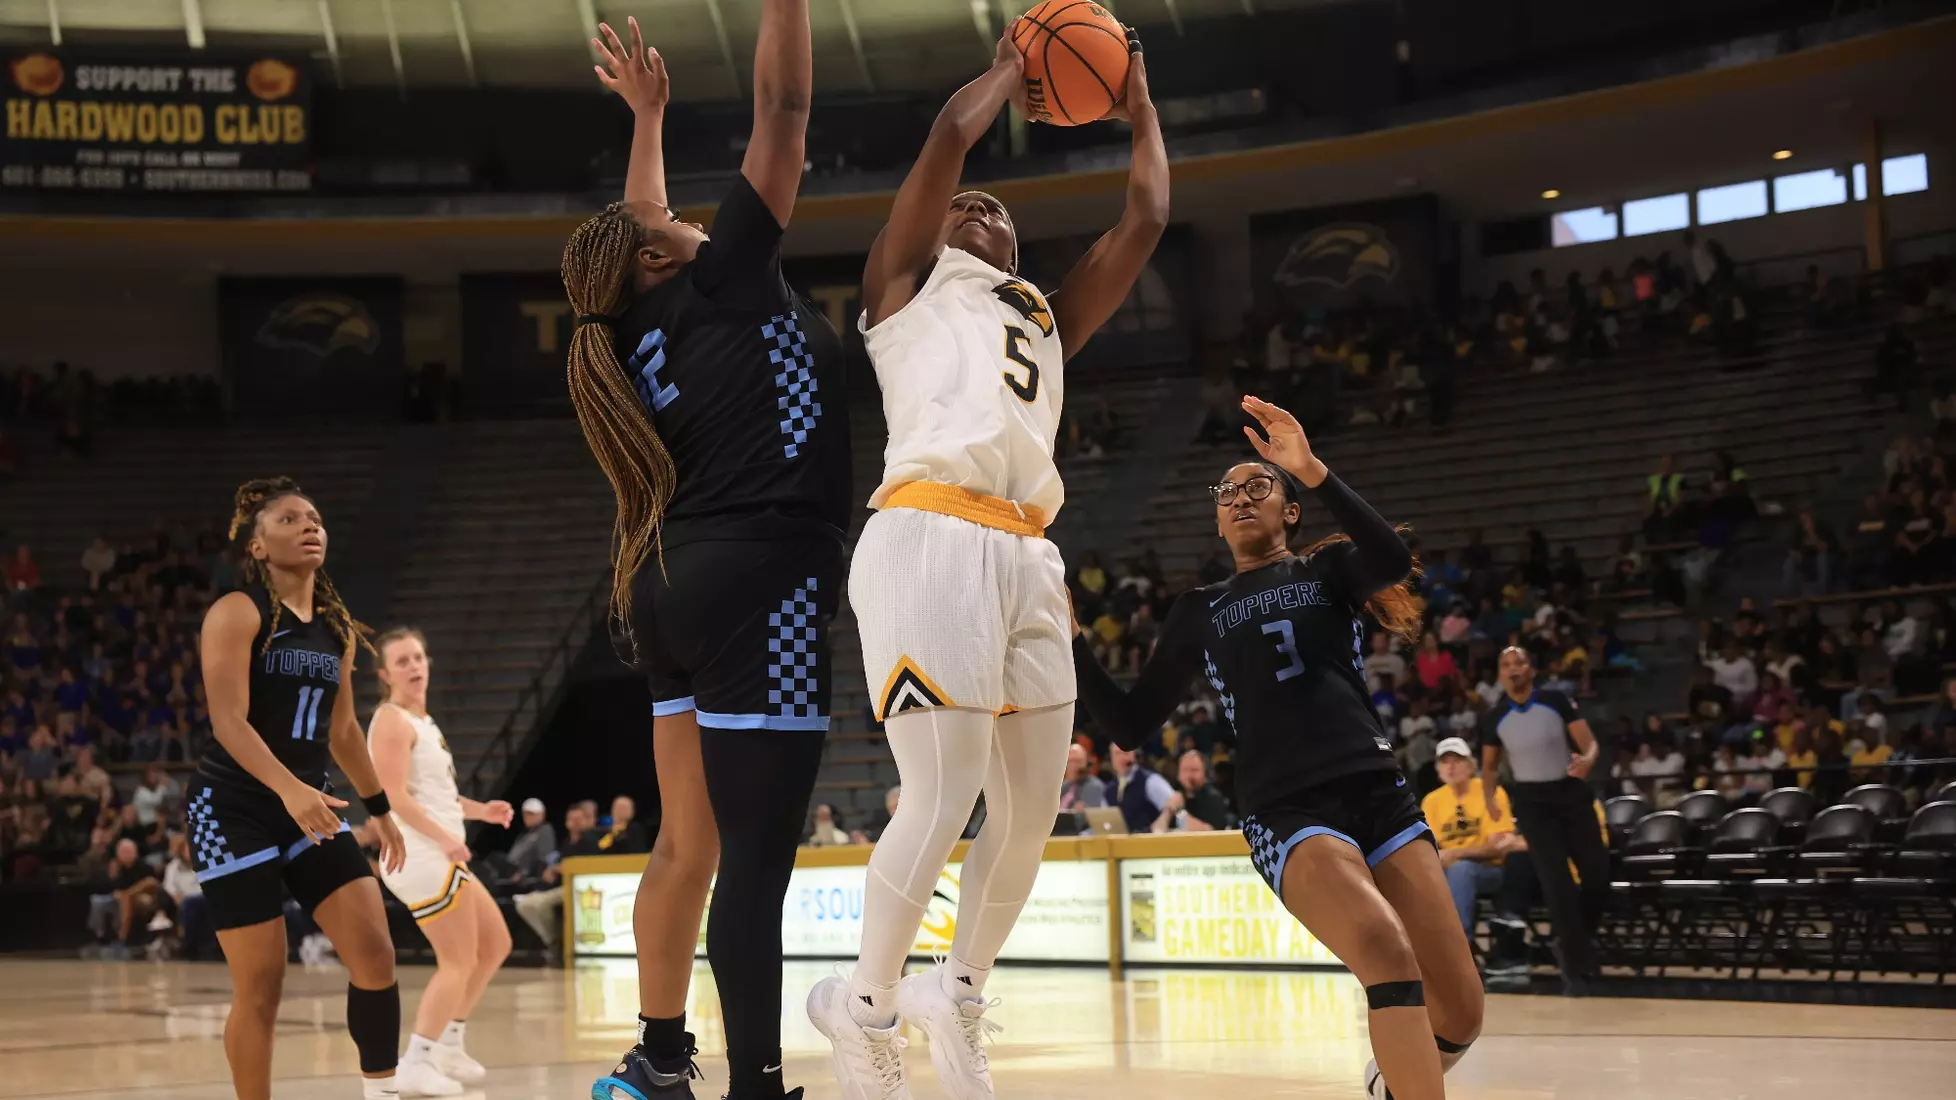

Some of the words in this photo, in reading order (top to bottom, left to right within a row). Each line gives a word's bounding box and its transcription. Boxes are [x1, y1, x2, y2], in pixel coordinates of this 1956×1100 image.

[75, 65, 182, 92] SUPPORT
[188, 68, 236, 93] THE
[6, 98, 205, 144] HARDWOOD
[215, 104, 306, 145] CLUB
[1002, 324, 1040, 404] 5
[1261, 619, 1306, 682] 3
[291, 685, 324, 740] 11
[1162, 883, 1276, 915] SOUTHERN
[1163, 917, 1281, 958] GAMEDAY
